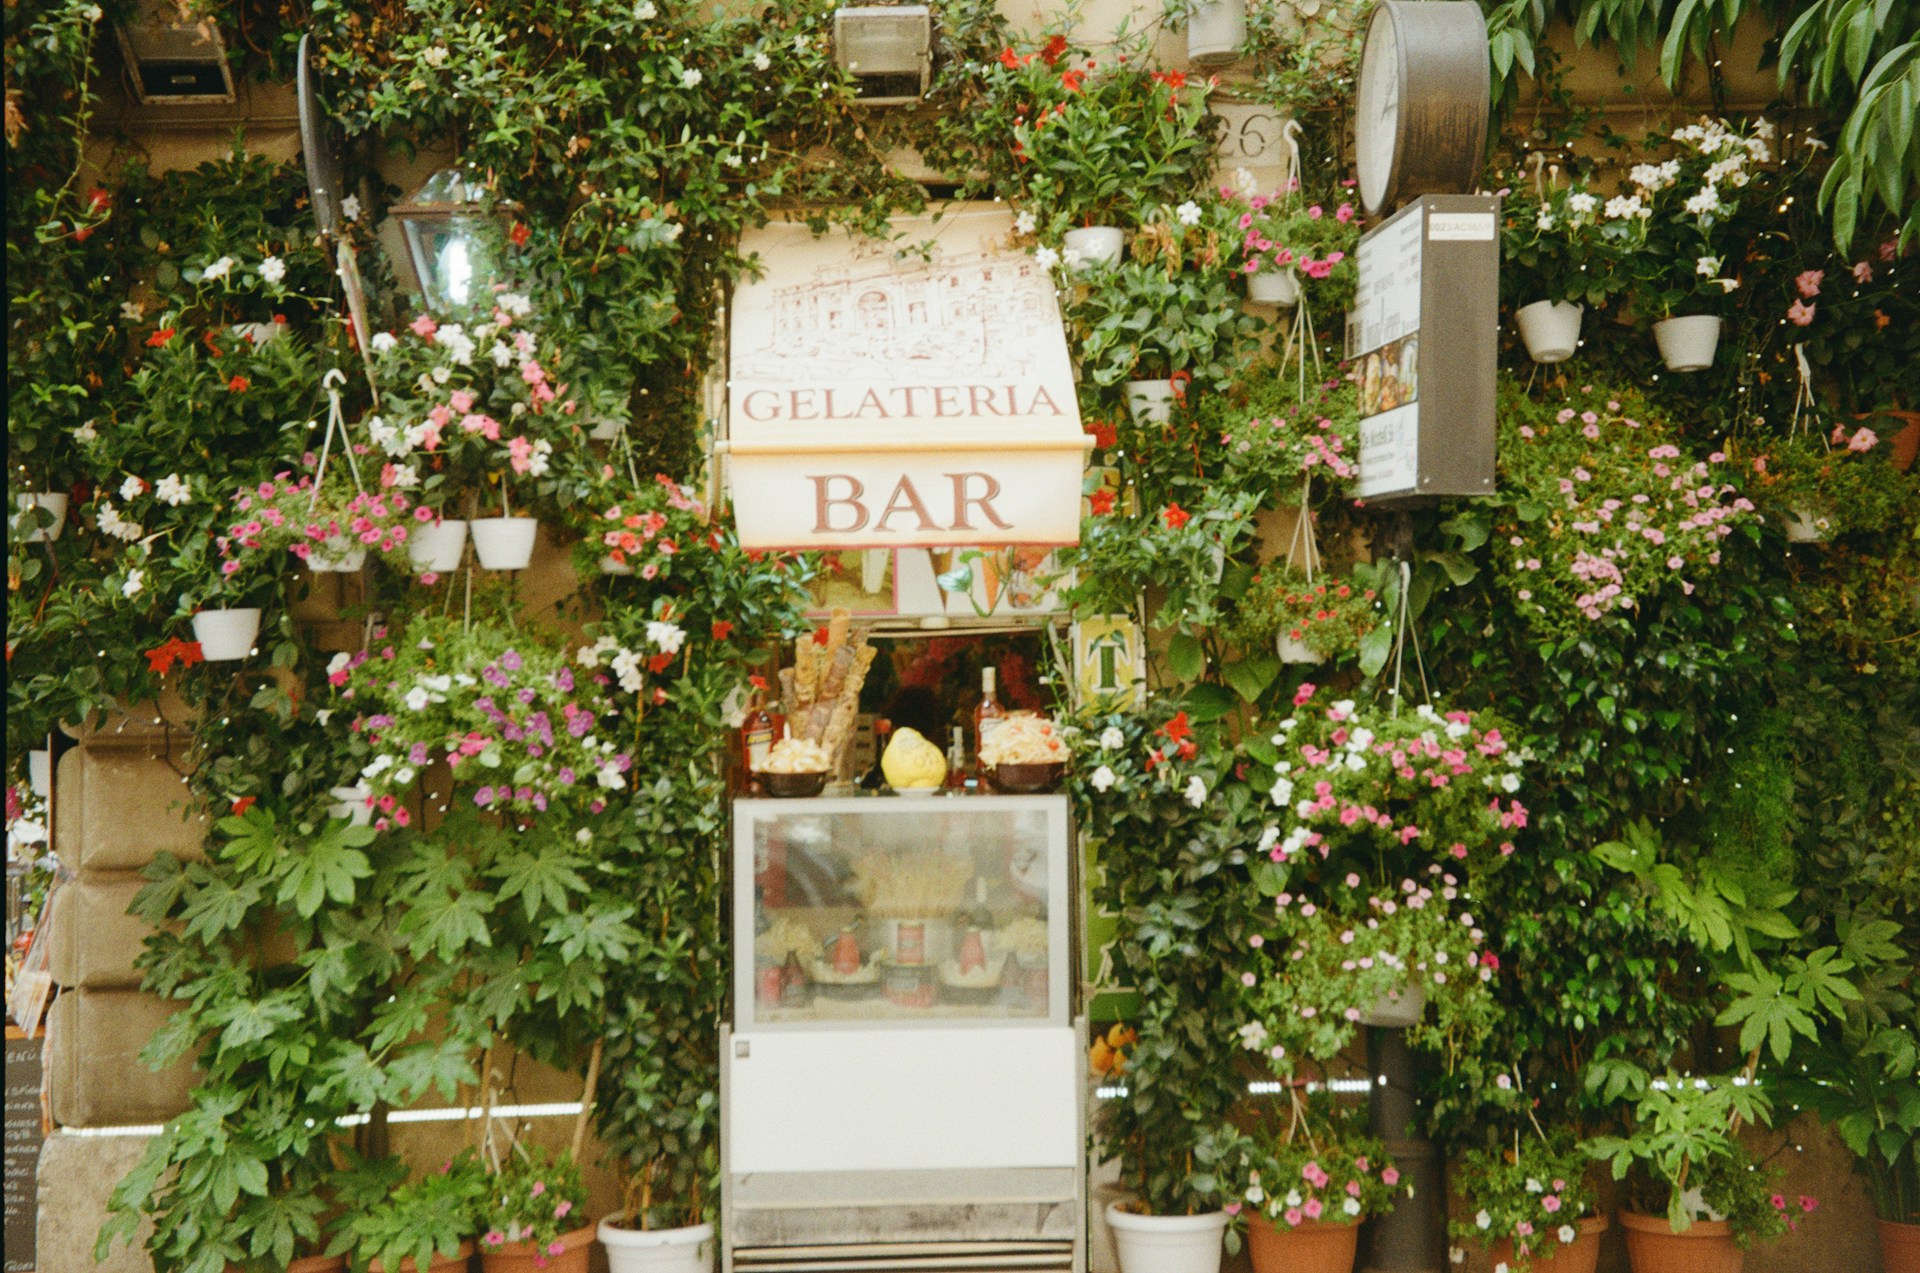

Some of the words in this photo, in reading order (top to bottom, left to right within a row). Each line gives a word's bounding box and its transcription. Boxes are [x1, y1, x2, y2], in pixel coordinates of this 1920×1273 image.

[1215, 114, 1272, 158] 26
[743, 385, 1065, 421] GELATERIA
[804, 471, 1015, 534] BAR
